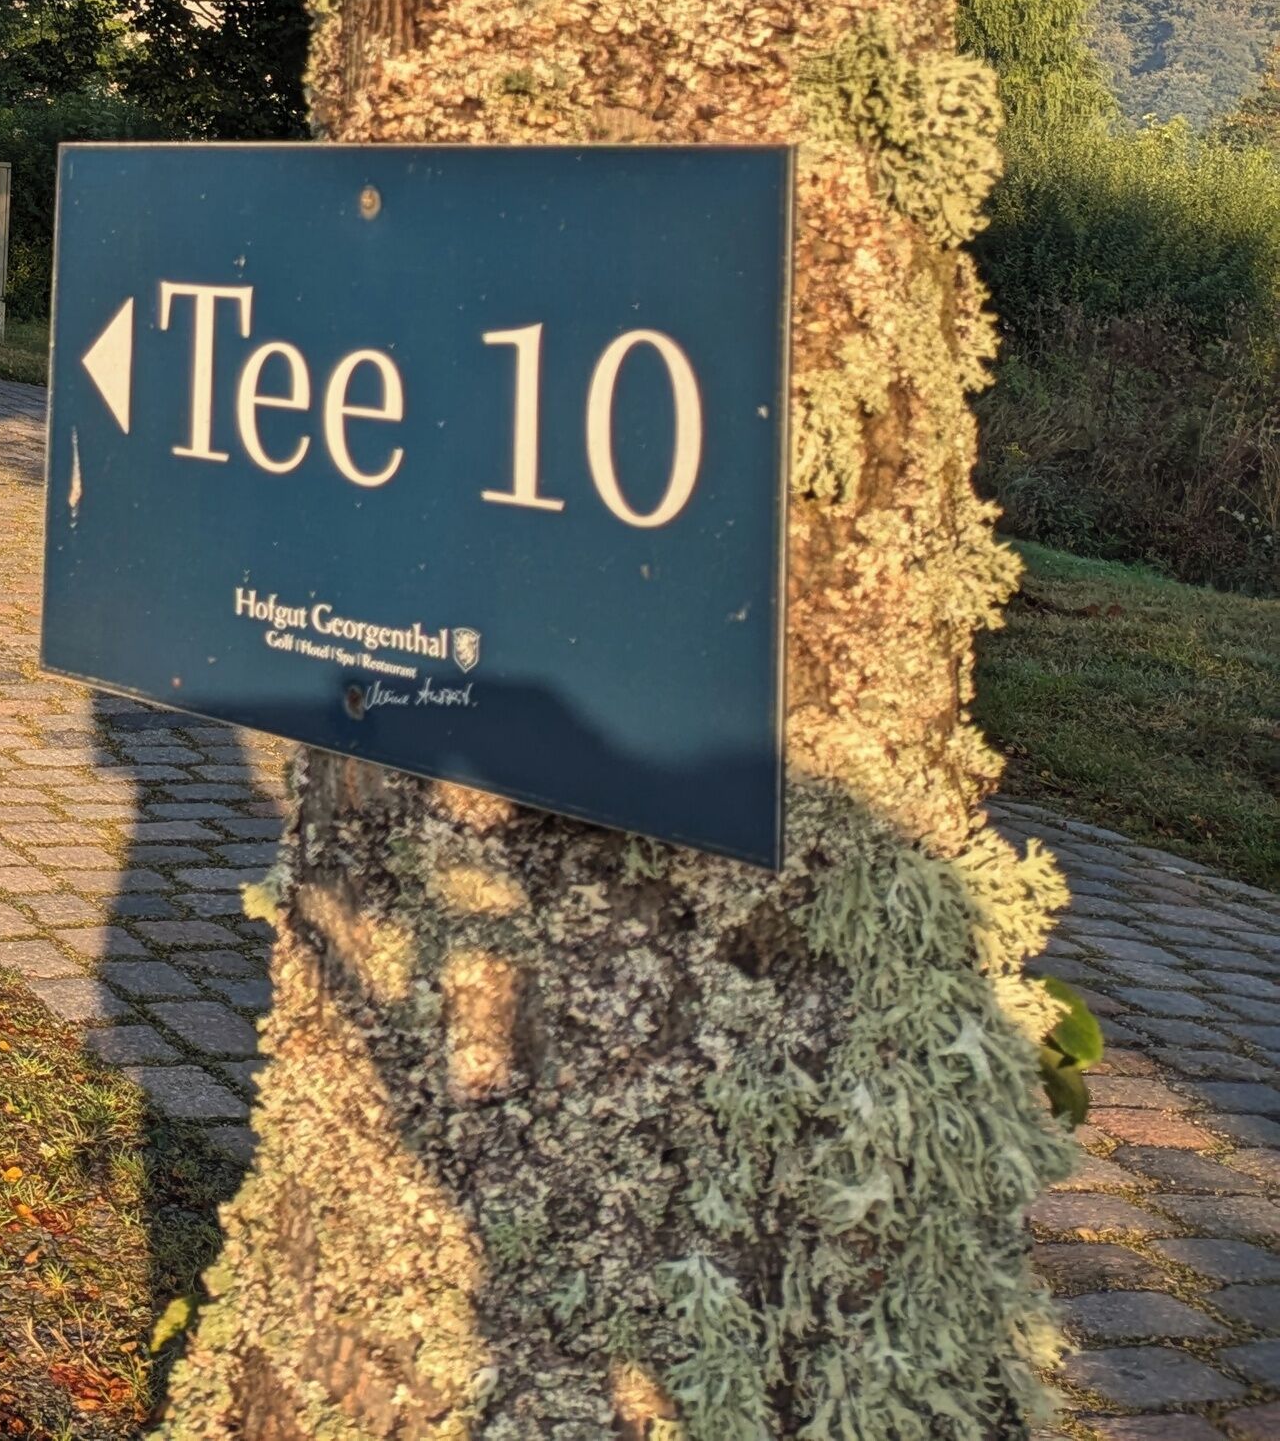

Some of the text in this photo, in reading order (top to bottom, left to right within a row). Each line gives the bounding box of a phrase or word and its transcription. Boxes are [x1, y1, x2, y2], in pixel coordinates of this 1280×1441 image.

[159, 281, 703, 529] Tee 10
[235, 587, 448, 659] Hofgut Georgenthal
[265, 630, 417, 679] Golf Hotel Spa Restaurant
